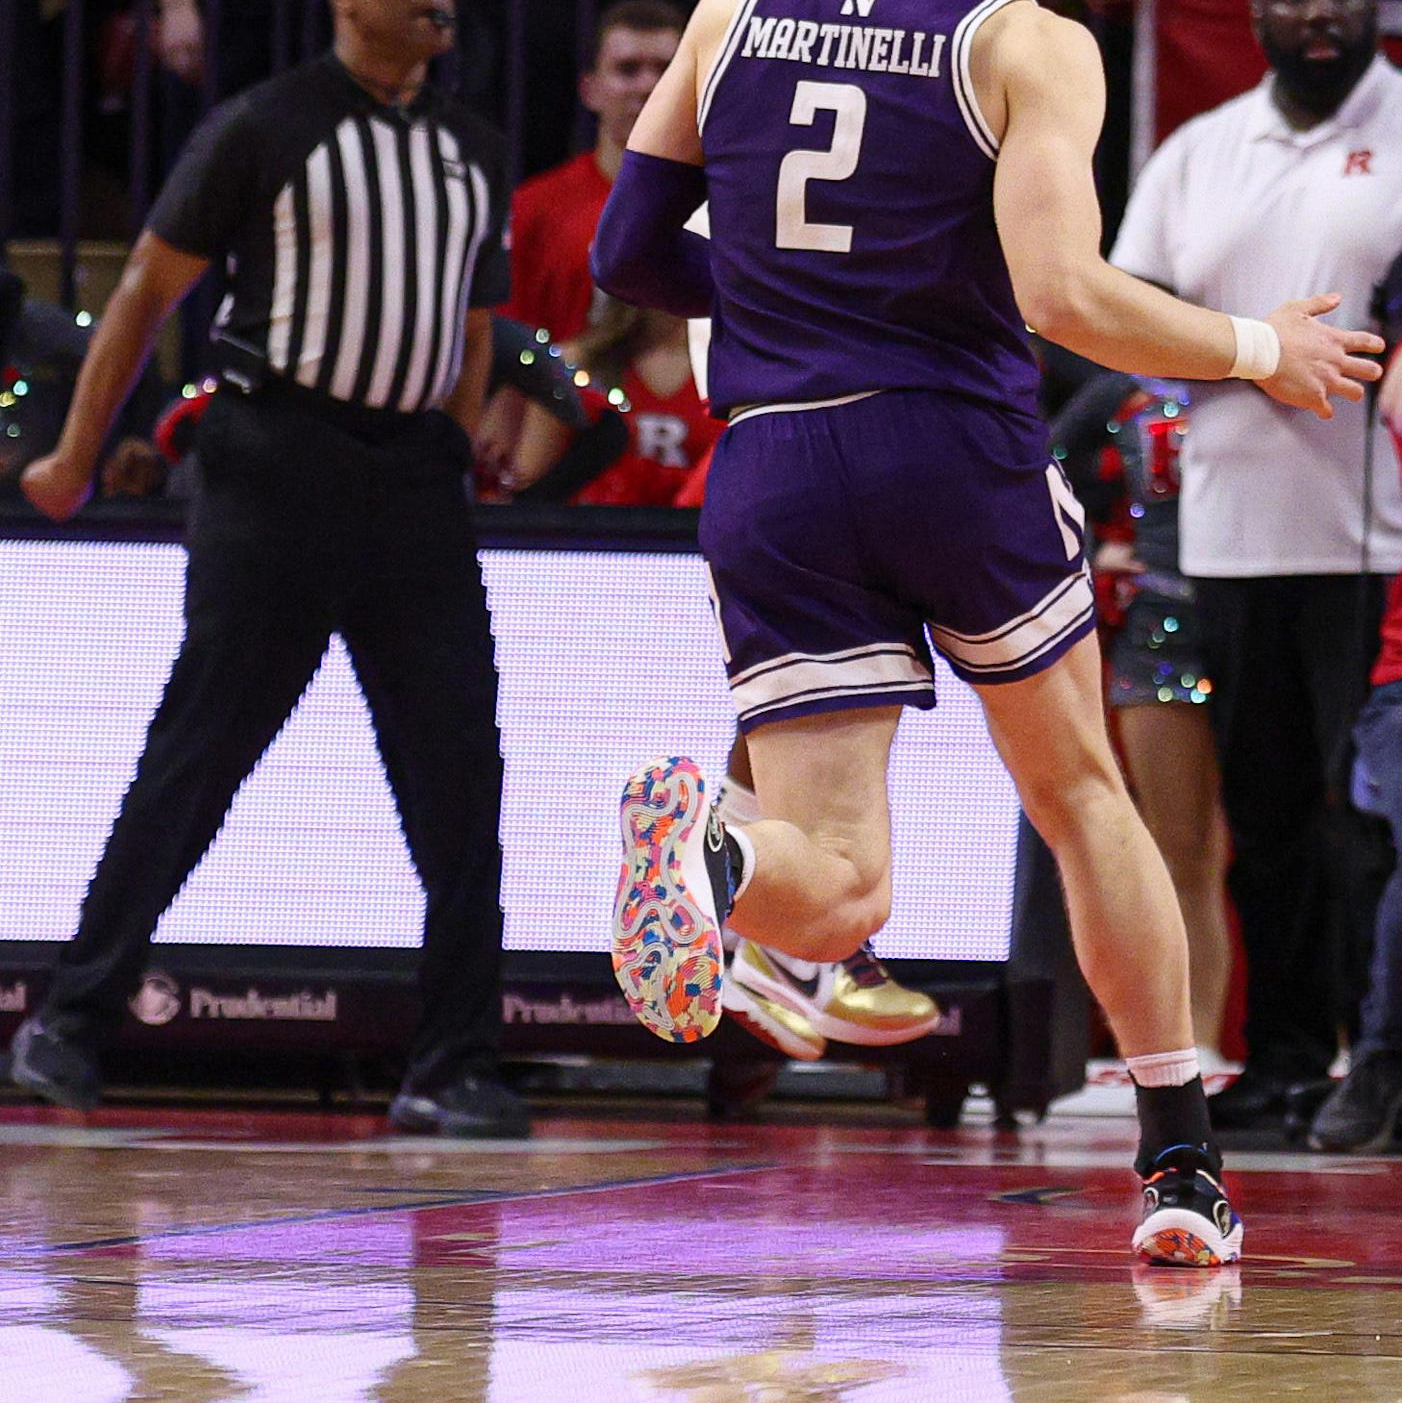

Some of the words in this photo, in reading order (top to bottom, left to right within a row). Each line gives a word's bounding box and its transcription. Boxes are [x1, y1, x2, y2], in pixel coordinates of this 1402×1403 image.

[741, 16, 946, 78] MARTINELLI
[776, 80, 868, 253] 2
[636, 413, 689, 467] R
[189, 987, 337, 1021] Prudential
[502, 993, 641, 1025] Prudentia
